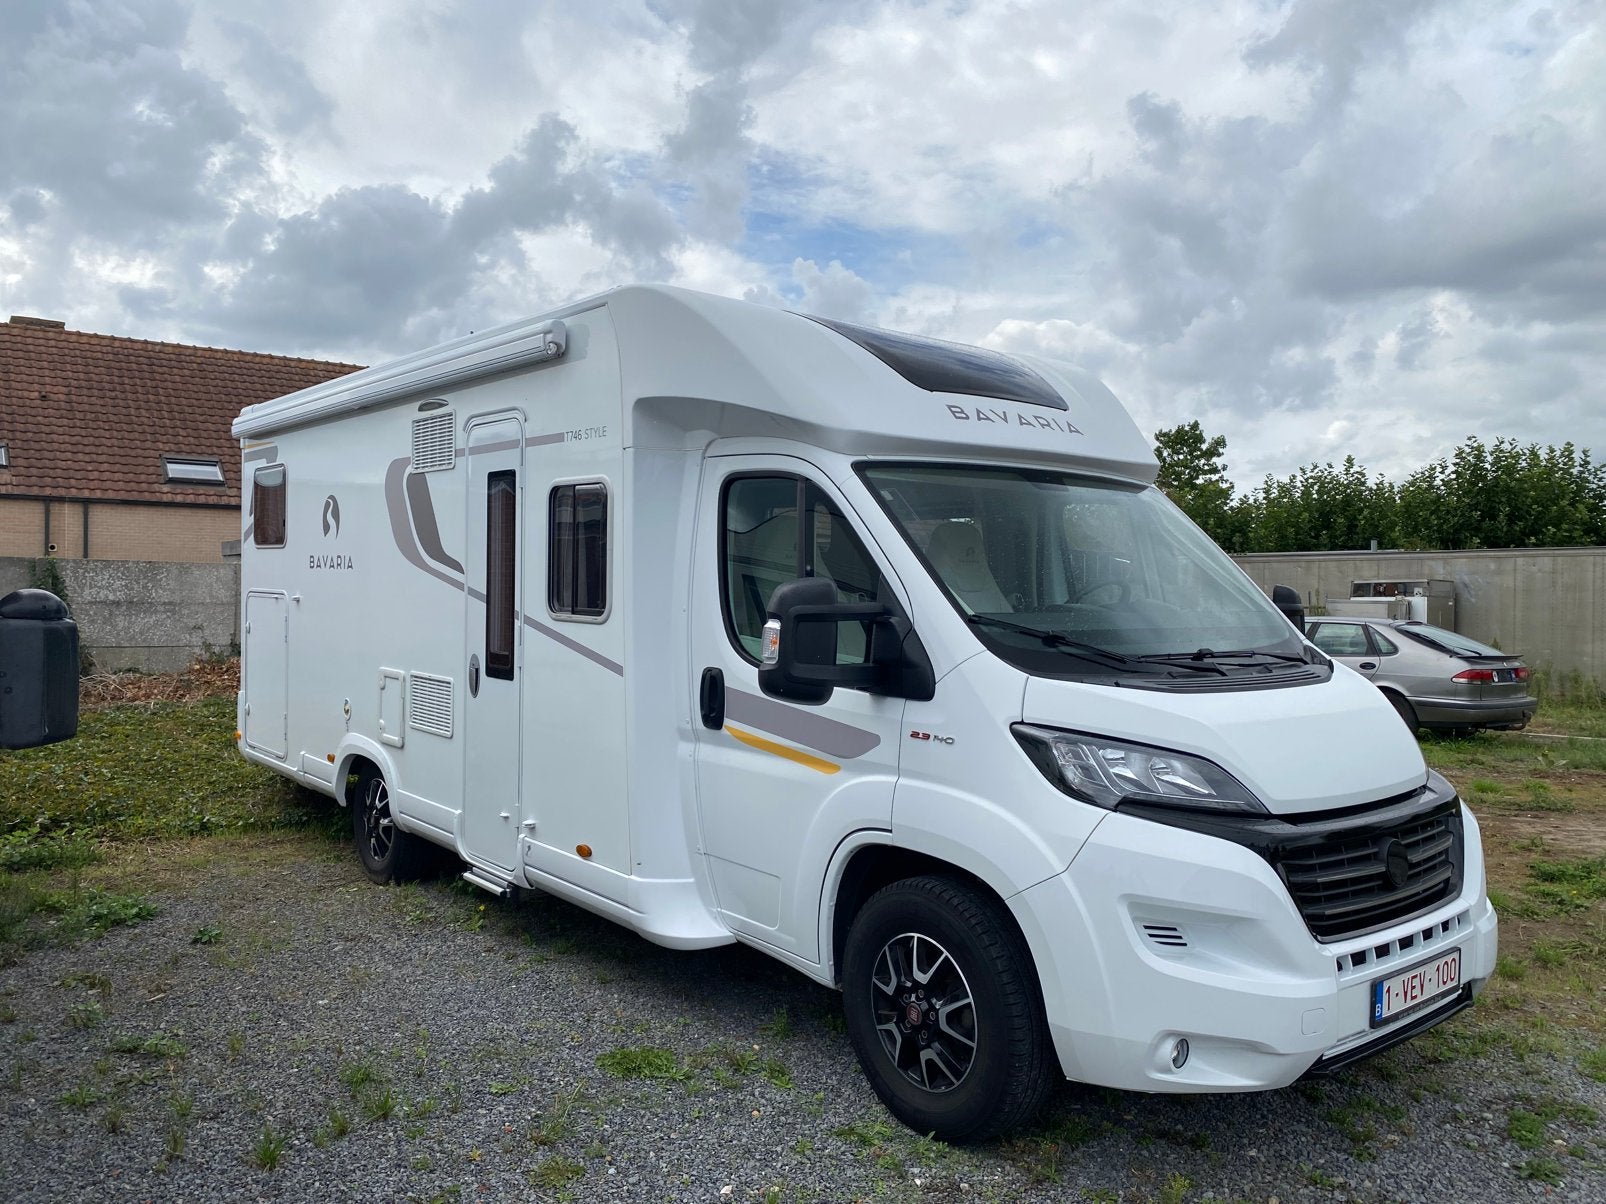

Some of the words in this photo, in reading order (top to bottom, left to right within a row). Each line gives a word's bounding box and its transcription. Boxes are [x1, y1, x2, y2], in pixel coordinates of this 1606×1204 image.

[946, 404, 1084, 436] BAVARIA
[565, 429, 582, 442] T746
[584, 425, 607, 440] STYLE
[309, 554, 354, 570] BAVARIA
[1375, 1003, 1382, 1017] B
